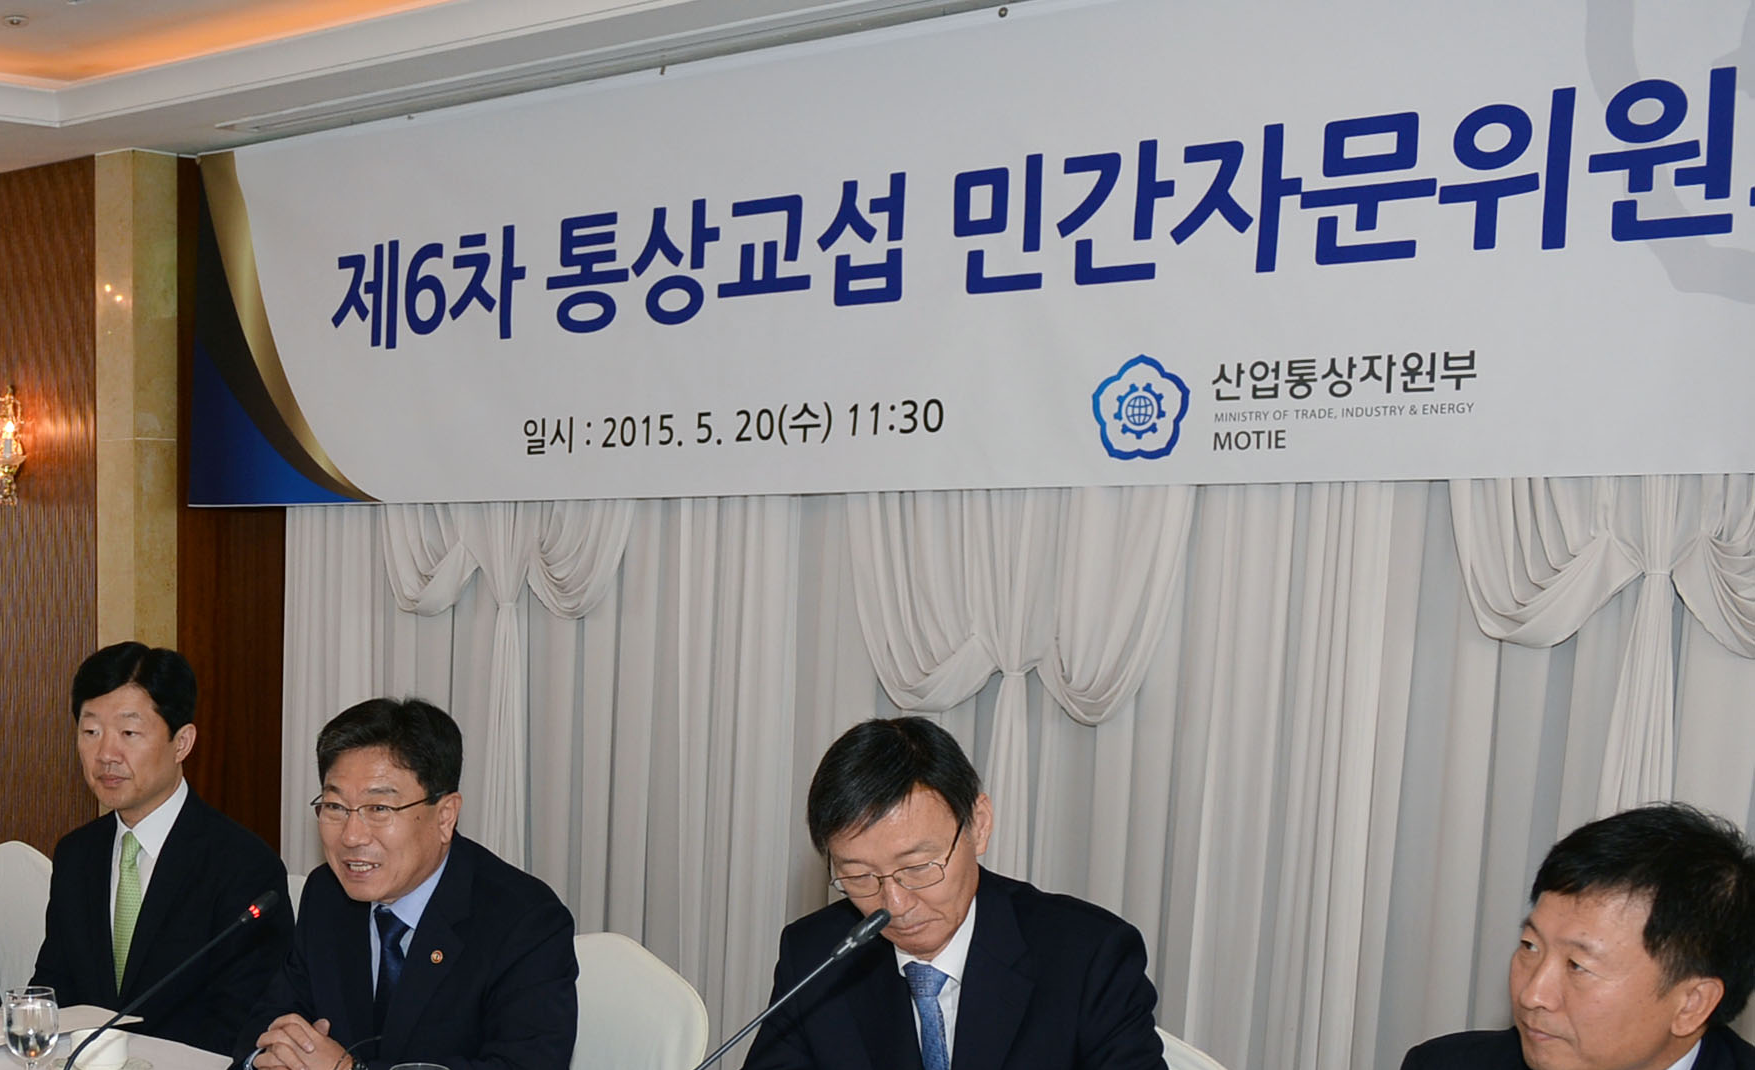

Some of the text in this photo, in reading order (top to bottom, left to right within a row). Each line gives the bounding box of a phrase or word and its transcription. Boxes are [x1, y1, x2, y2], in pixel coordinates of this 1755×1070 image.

[331, 66, 1755, 349] 제6차 통상교섭 민간자문위원
[1212, 350, 1477, 401] 산업통상자원부
[523, 416, 574, 455] 일시
[601, 413, 684, 448] 2015.
[695, 411, 723, 446] 5.
[734, 401, 833, 446] 20(수)
[847, 398, 945, 437] 11:30
[1213, 402, 1475, 423] MINISTRY OF TRADE, INDUSTRY & ENERGY
[1212, 429, 1287, 451] MOTIE
